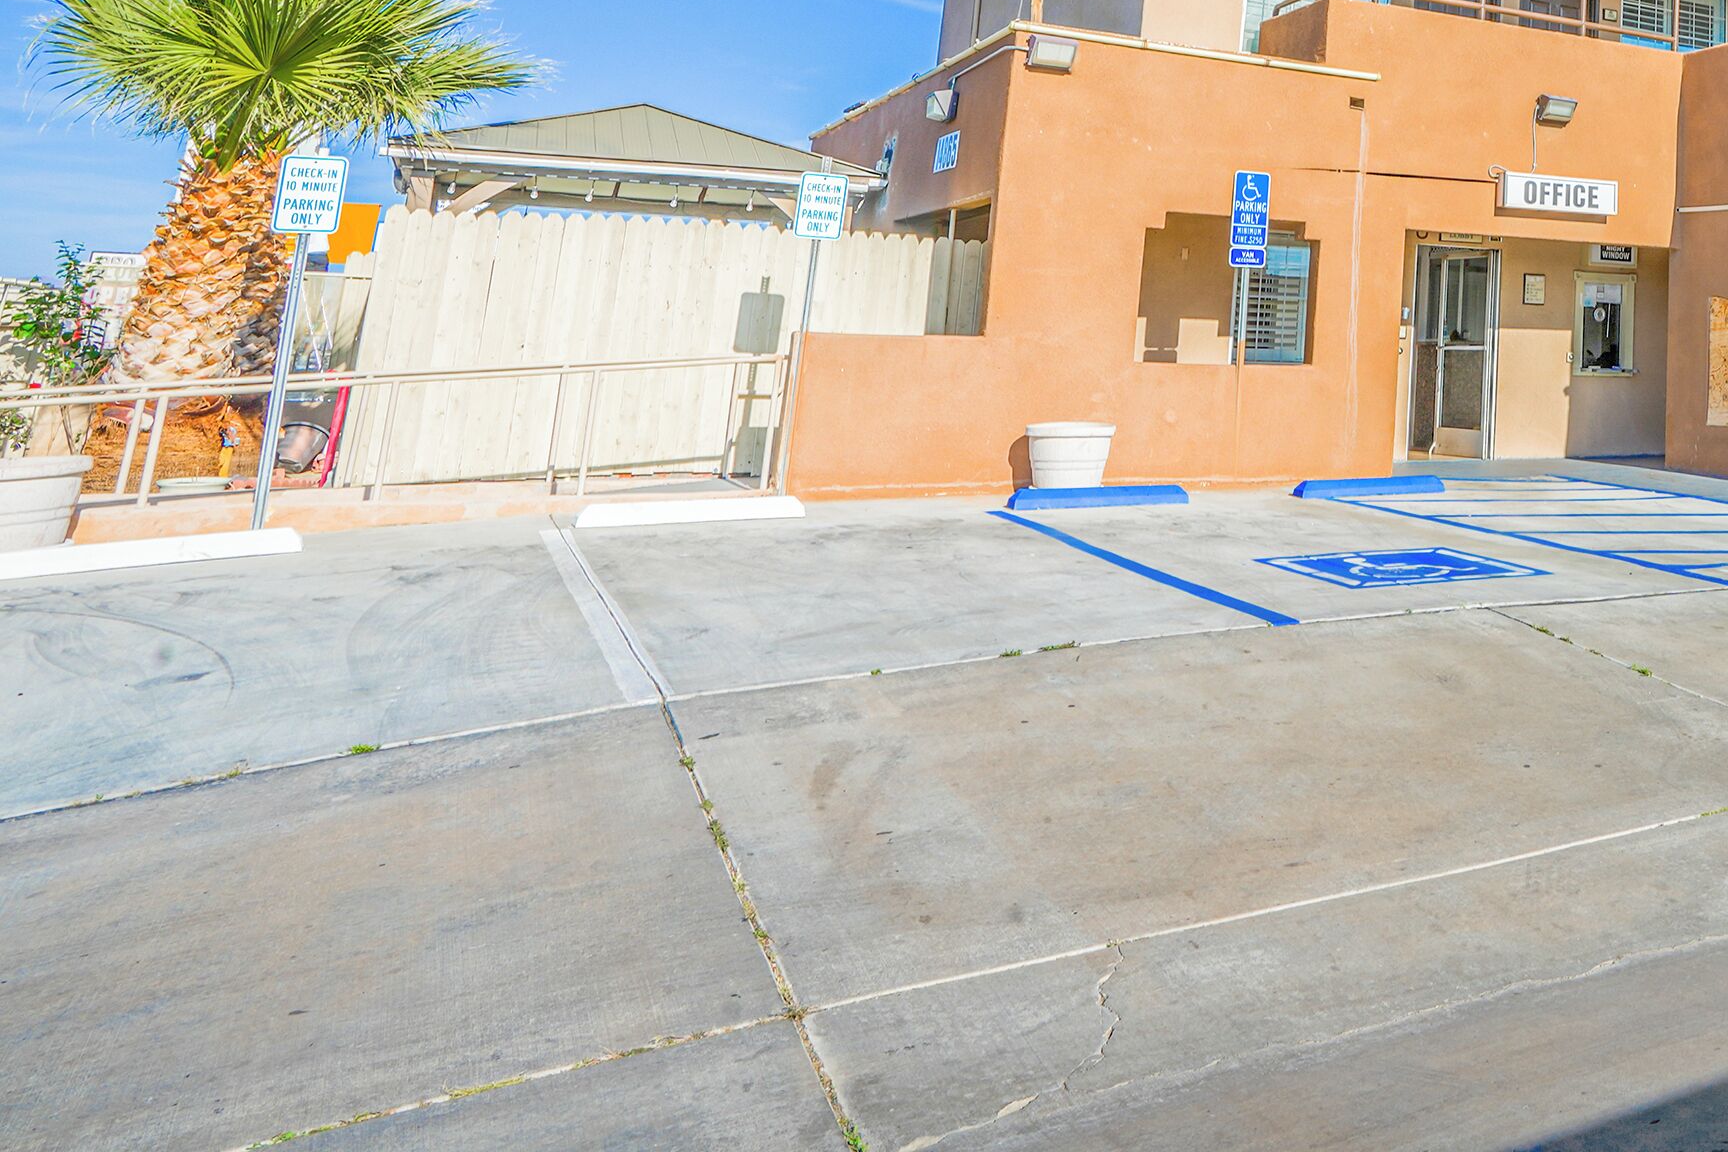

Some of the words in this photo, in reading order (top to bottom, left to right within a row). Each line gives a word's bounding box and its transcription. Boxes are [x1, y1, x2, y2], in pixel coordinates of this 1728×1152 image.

[291, 167, 338, 179] CHECK-IN
[286, 180, 297, 191] 10
[301, 181, 338, 192] MINUTE
[807, 183, 842, 194] CHECK-IN
[803, 194, 812, 204] 10
[815, 195, 842, 206] MINUTE
[1523, 180, 1599, 209] OFFICE
[283, 198, 334, 211] PARKING
[1235, 200, 1267, 213] PARKING
[291, 212, 323, 225] ONLY
[801, 208, 839, 222] PARKING
[1240, 213, 1260, 224] ONLY
[807, 221, 830, 233] ONLY
[1236, 227, 1262, 236] MINIMUM
[1234, 235, 1248, 244] FINE
[1241, 251, 1255, 259] VAN
[1602, 251, 1630, 260] WINDOW
